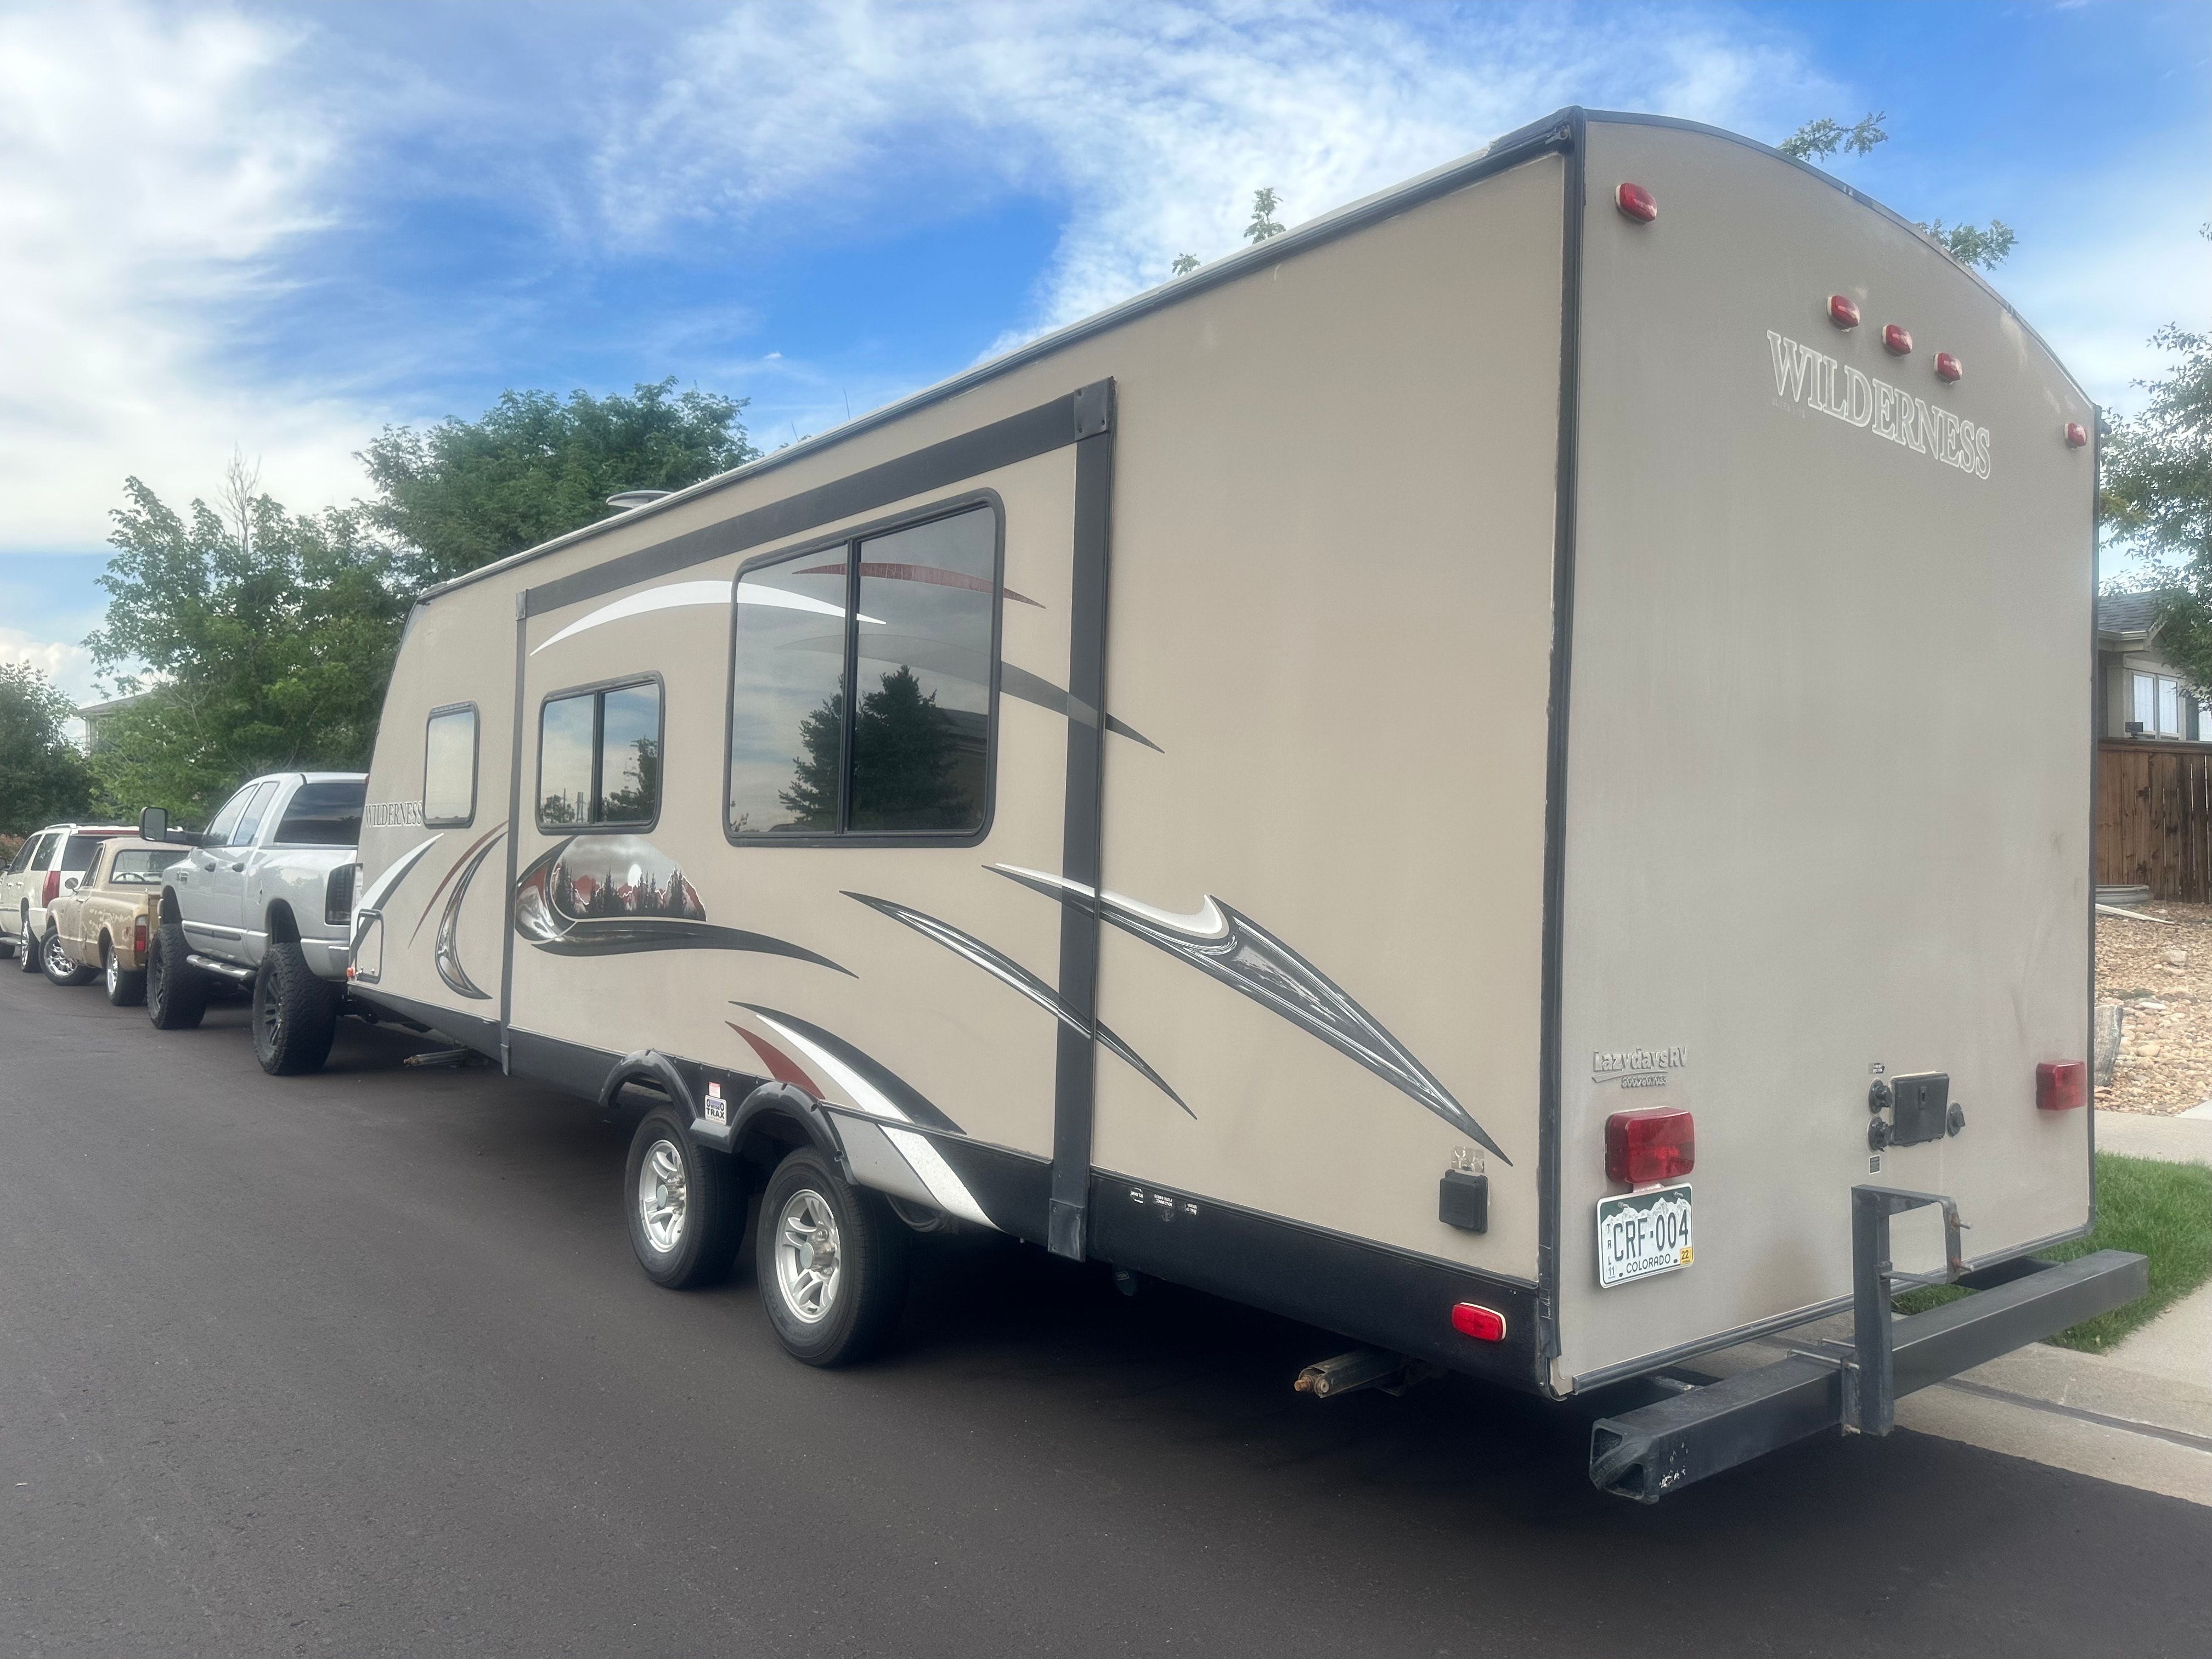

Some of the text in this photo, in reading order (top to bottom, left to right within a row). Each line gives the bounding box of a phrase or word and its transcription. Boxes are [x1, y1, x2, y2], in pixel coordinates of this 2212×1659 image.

[1767, 330, 1990, 480] WILDERNESS
[365, 800, 422, 828] WILDERNESS
[706, 1108, 725, 1120] TRAX
[1681, 1250, 1689, 1260] 22
[1608, 1266, 1615, 1277] 11
[1626, 1254, 1671, 1274] COLORADO
